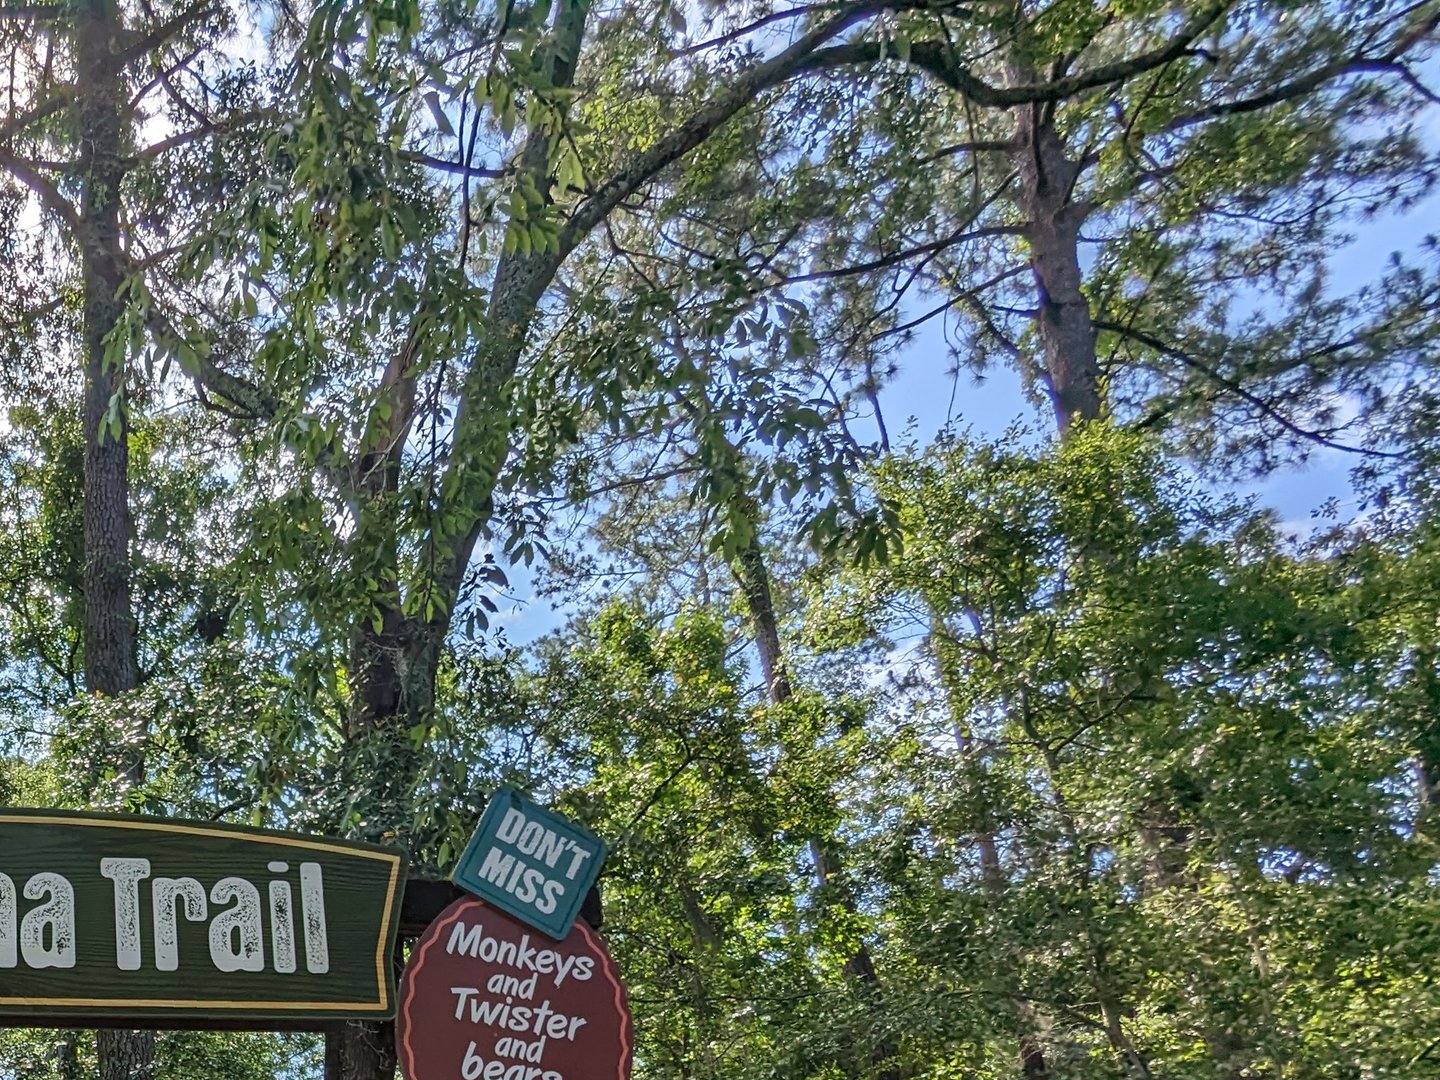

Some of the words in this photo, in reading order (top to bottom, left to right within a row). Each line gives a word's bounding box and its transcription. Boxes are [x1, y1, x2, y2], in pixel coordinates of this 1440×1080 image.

[495, 806, 591, 881] DON'T
[478, 846, 566, 916] MISS
[99, 857, 331, 974] Trail
[445, 921, 595, 986] Monkeys
[487, 971, 539, 1001] and
[450, 987, 588, 1042] Twister
[495, 1035, 547, 1064] and
